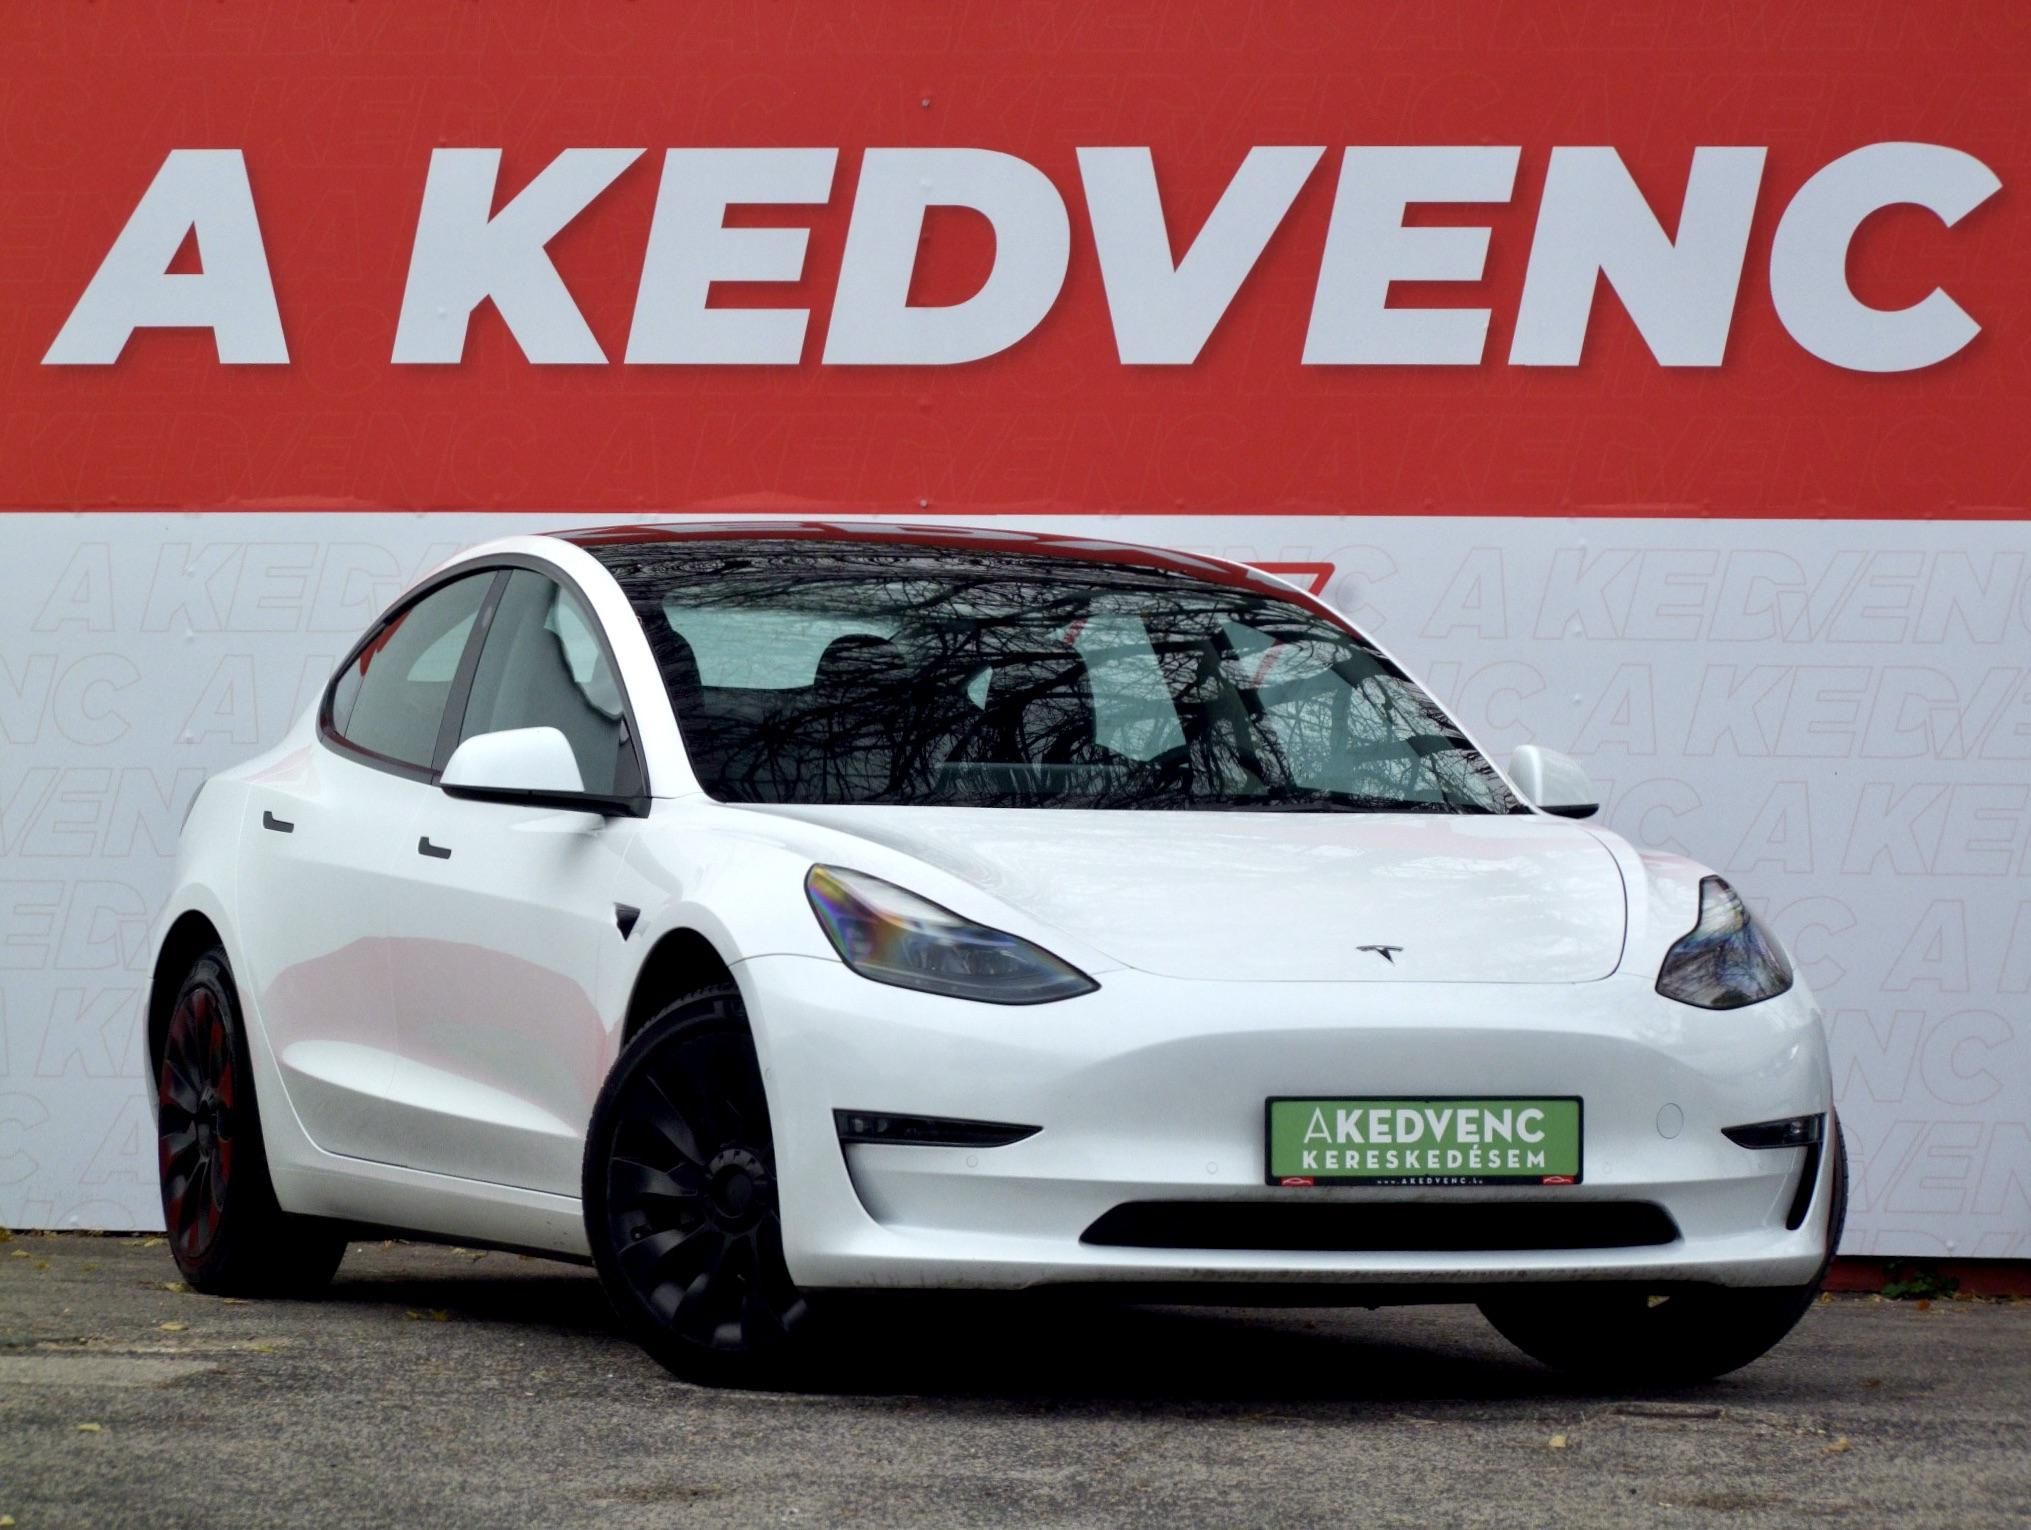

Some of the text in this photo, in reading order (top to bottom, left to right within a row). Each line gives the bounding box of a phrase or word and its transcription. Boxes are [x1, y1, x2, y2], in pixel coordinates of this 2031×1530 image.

[41, 148, 291, 366] A
[391, 141, 2002, 373] KEDVENC
[1302, 1144, 1546, 1169] KERESKEDÉSEM
